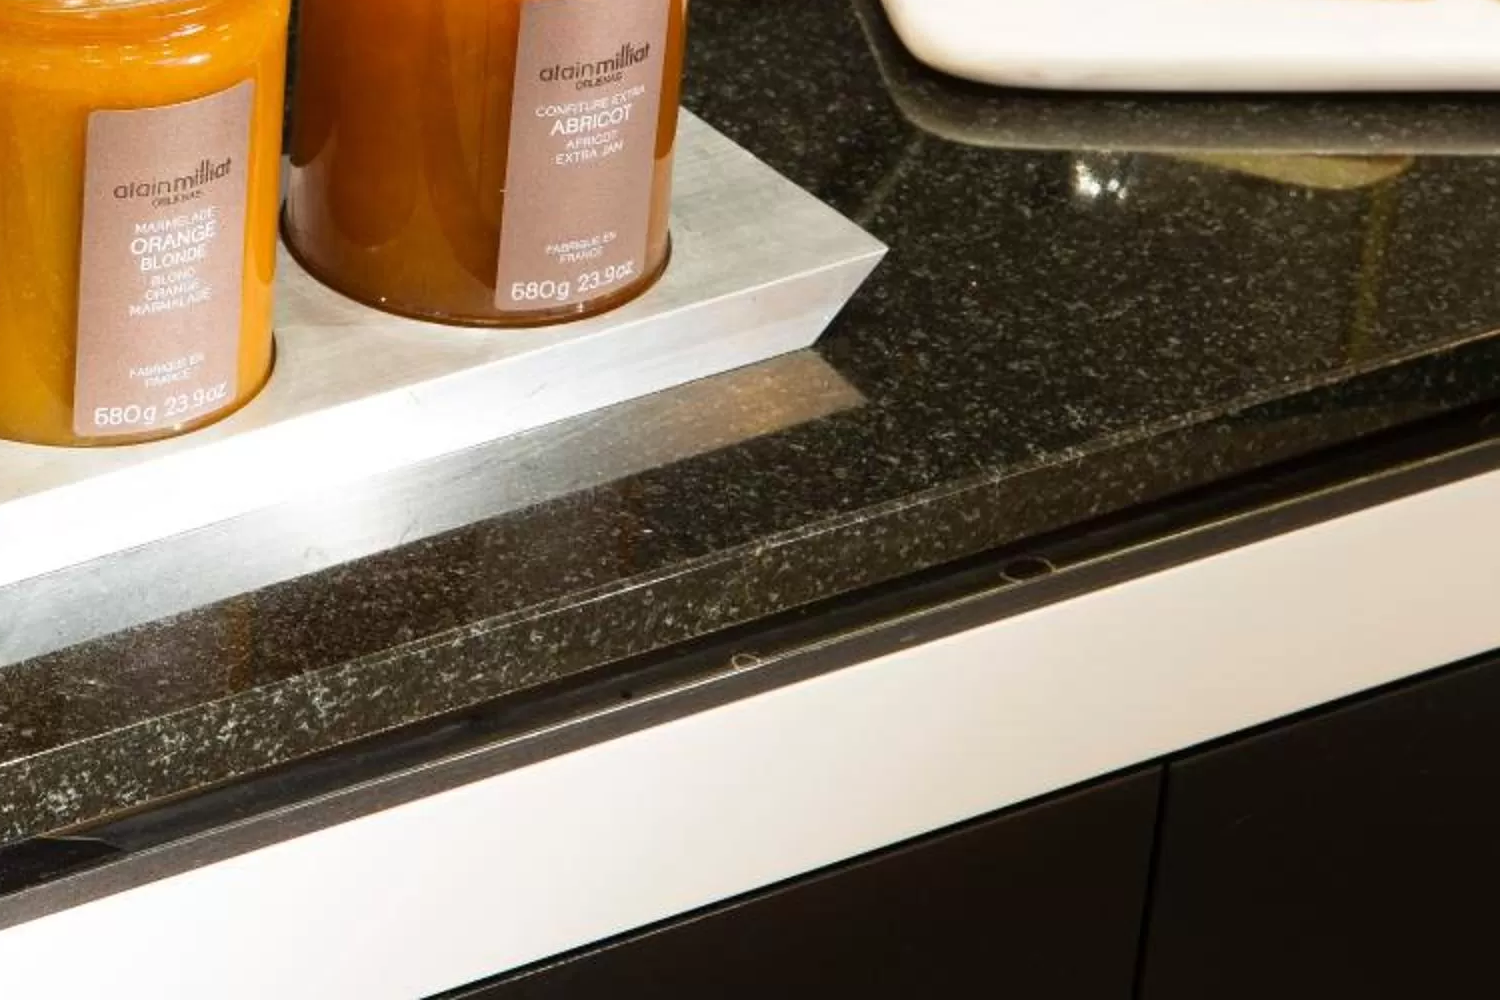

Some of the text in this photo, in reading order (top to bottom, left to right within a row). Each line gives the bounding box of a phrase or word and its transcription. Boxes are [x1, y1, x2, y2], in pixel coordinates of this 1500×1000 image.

[549, 102, 633, 137] ABRICOT
[554, 147, 599, 165] EXTRA
[130, 220, 216, 256] ORANGE
[139, 245, 207, 272] BLONDE
[510, 279, 571, 302] 680g
[93, 403, 157, 426] 680g
